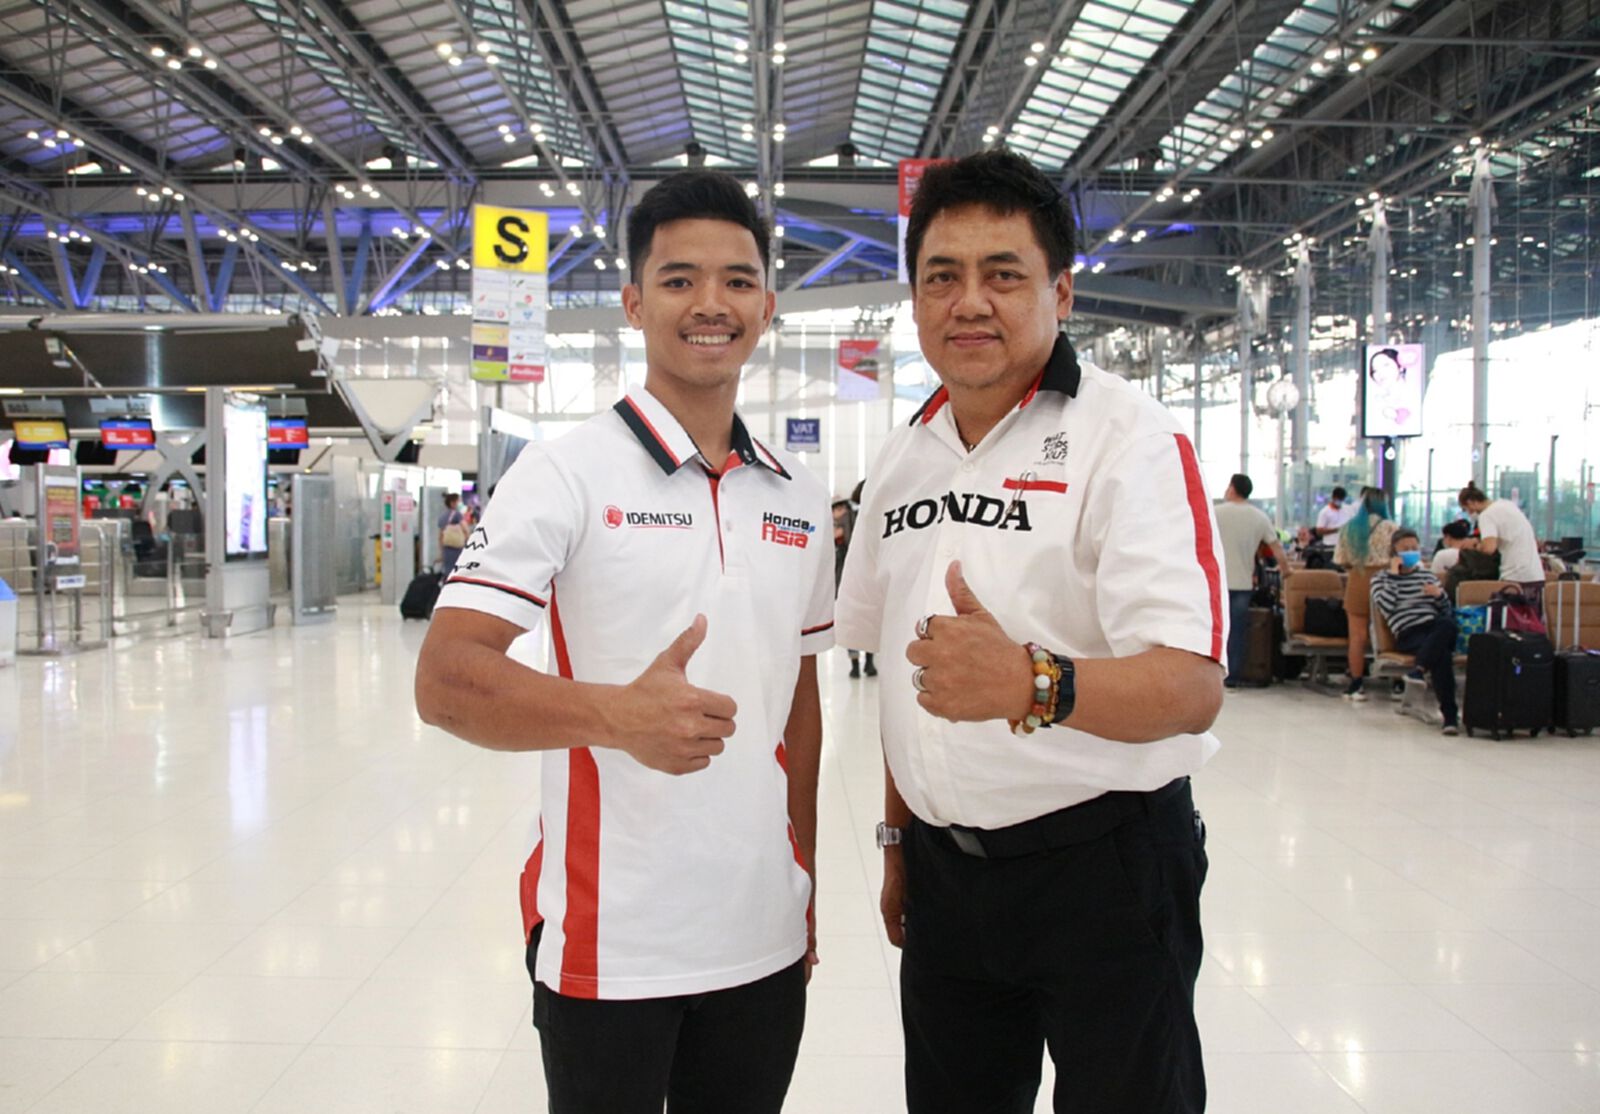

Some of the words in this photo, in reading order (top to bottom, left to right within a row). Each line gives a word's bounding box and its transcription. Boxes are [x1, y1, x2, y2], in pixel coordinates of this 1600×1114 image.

[493, 215, 530, 264] S
[791, 422, 816, 434] VAT
[626, 512, 693, 526] IDEMITSU
[763, 512, 810, 530] Honda
[882, 490, 1032, 539] HONDA
[761, 523, 808, 549] Asia
